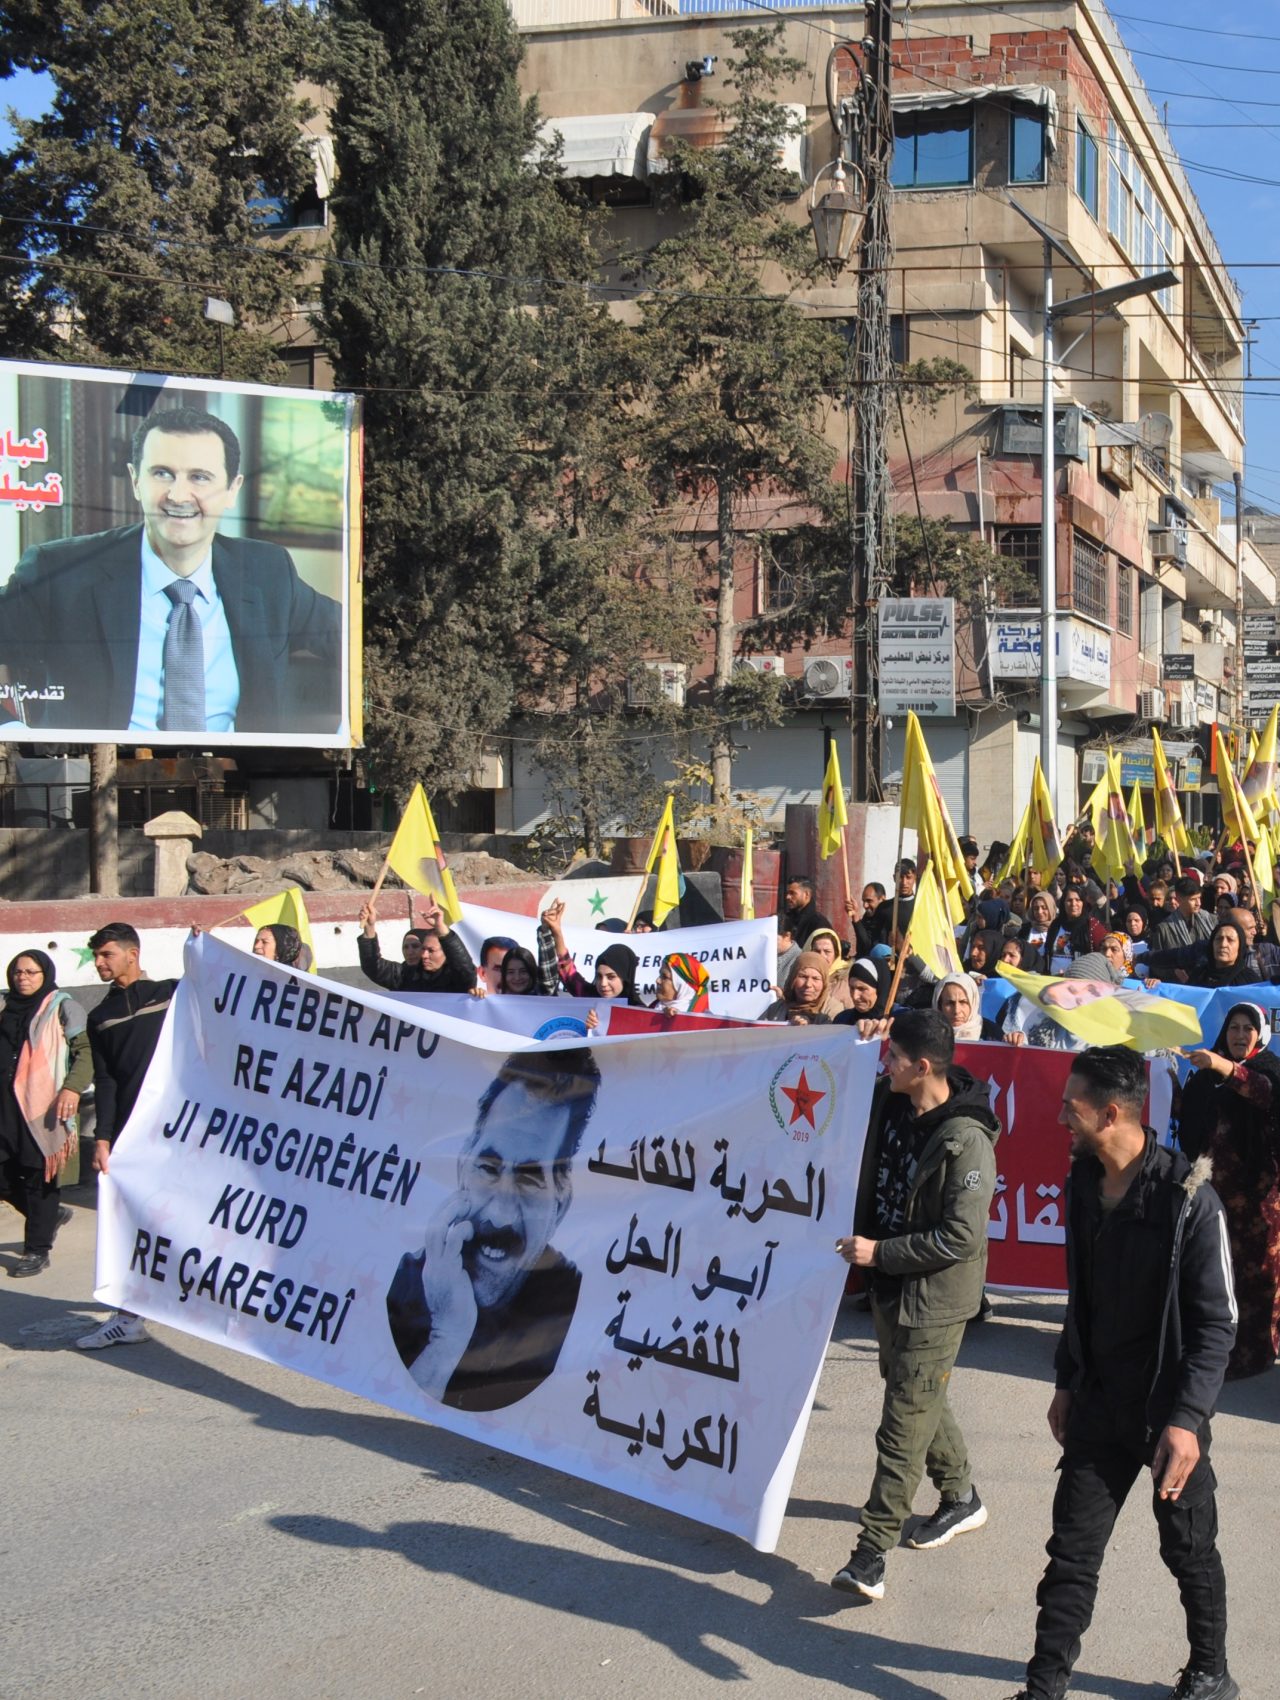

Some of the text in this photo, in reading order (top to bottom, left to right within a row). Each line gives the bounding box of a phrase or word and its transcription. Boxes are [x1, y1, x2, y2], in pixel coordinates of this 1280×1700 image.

[0, 428, 47, 467] نبا
[0, 473, 62, 510] قبيل
[883, 605, 944, 621] PULSE
[918, 630, 938, 639] CENTER
[933, 651, 950, 664] مركز
[214, 973, 441, 1060] JI RÊBER APO
[738, 979, 771, 993] APO
[233, 1044, 388, 1121] RE AZADÎ
[163, 1099, 421, 1206] JI PIRSGIRÊKÊN
[587, 1135, 696, 1192] للقائد
[792, 1130, 810, 1142] 2019
[709, 1138, 826, 1223] الحرية
[208, 1184, 308, 1250] KURD
[129, 1228, 356, 1345] RE ÇARESERÎ
[605, 1212, 780, 1312] آبو الحل
[604, 1289, 740, 1383] للقضية
[582, 1369, 738, 1474] الكردية
